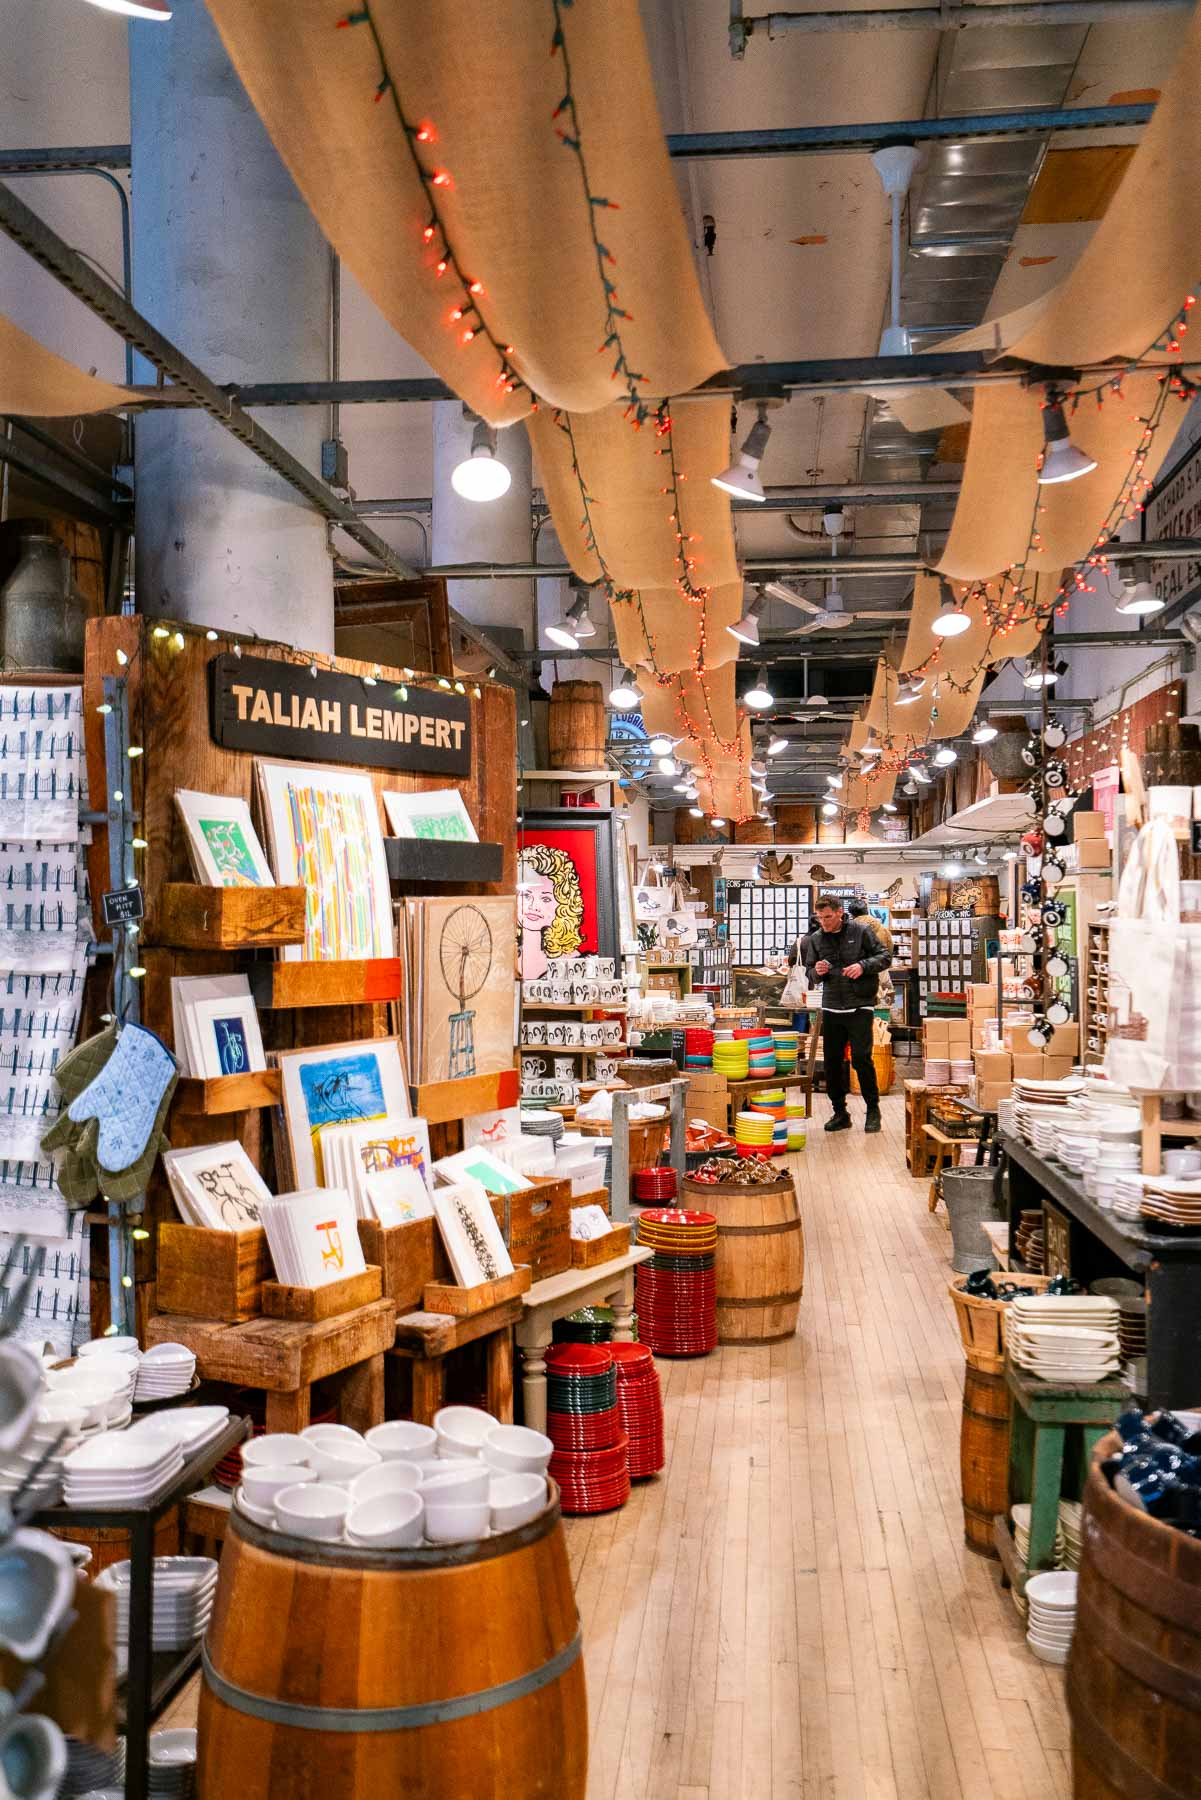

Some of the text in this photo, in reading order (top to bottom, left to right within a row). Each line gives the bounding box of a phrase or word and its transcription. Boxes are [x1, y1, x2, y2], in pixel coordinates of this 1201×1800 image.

[232, 684, 466, 750] TALIAH LEMPERT
[109, 895, 128, 905] OVEN
[116, 901, 134, 912] MITT
